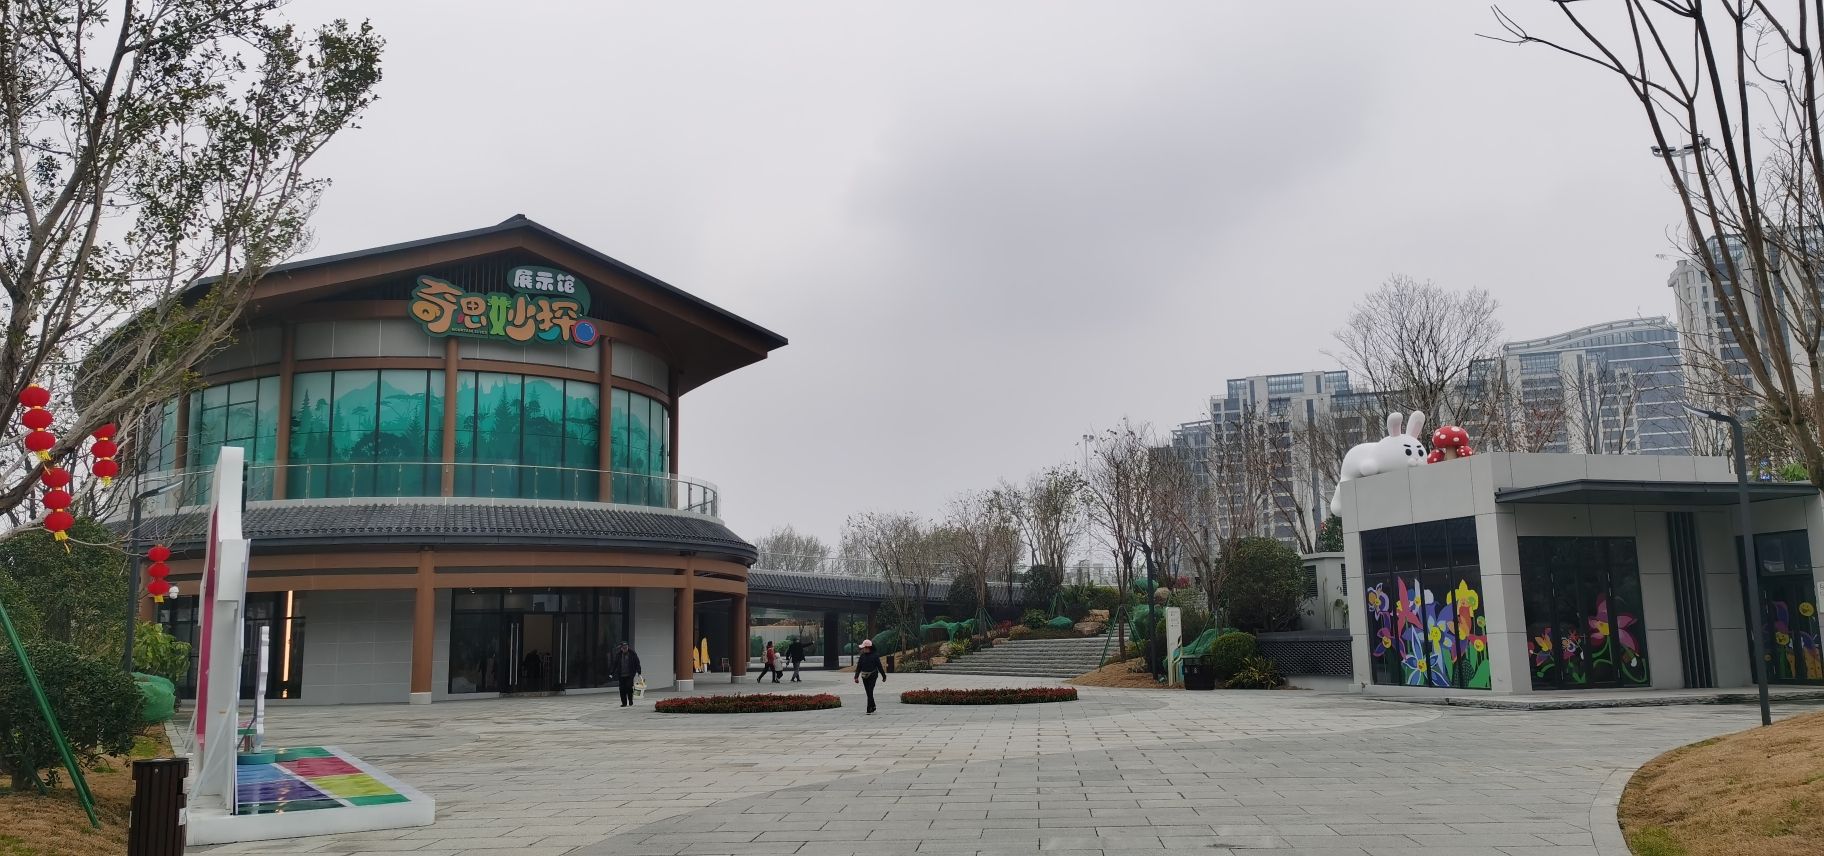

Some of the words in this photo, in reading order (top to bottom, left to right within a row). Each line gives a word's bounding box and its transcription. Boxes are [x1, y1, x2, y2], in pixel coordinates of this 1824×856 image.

[514, 269, 575, 294] 展示馆
[413, 278, 579, 341] 奇思妙探
